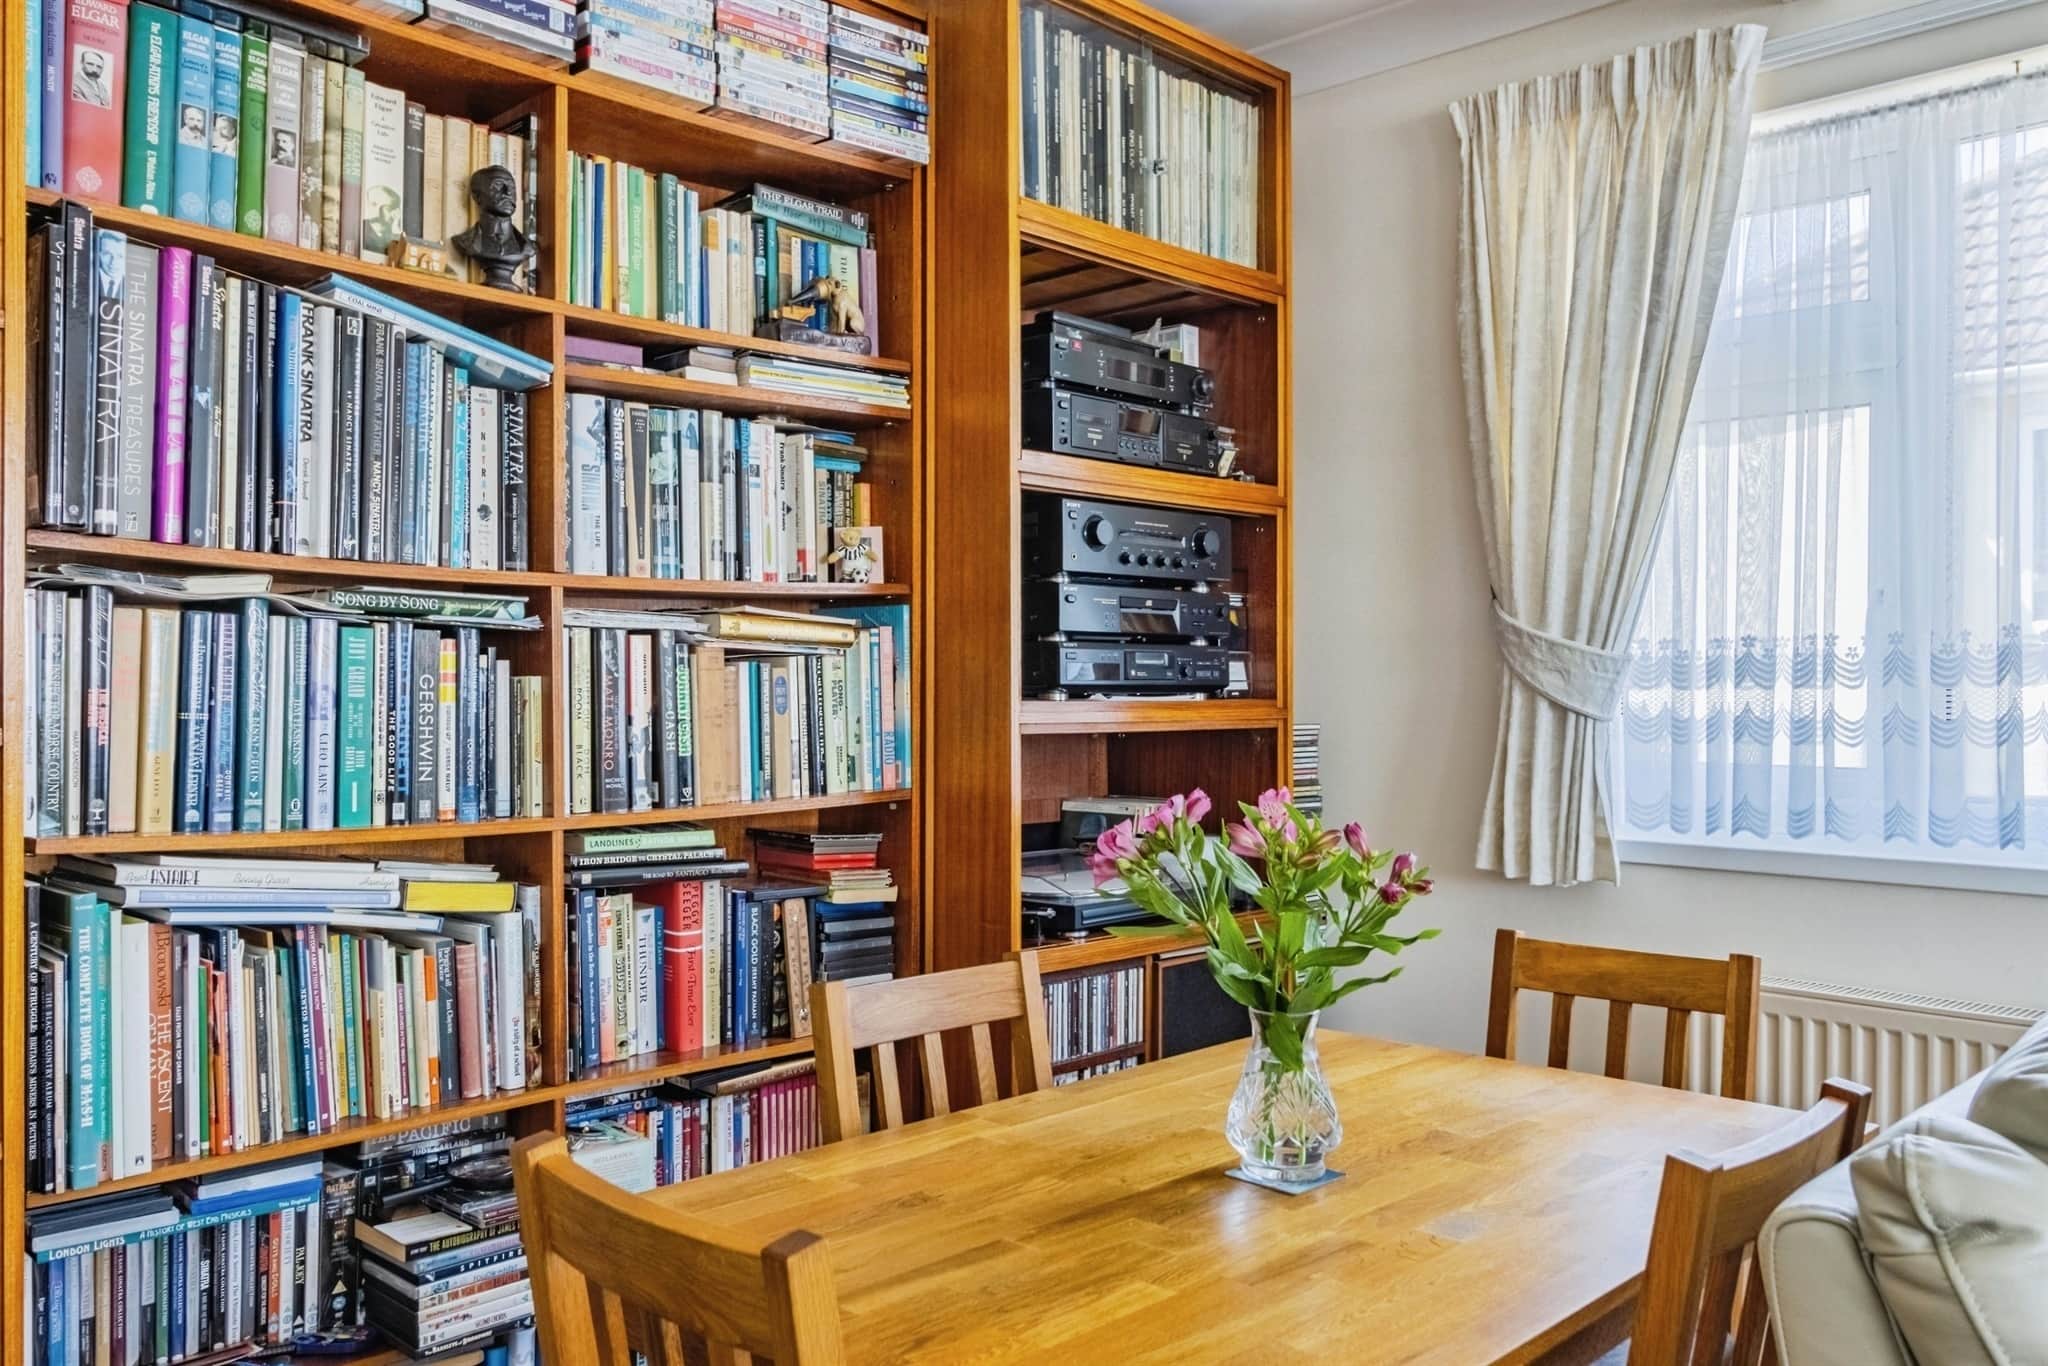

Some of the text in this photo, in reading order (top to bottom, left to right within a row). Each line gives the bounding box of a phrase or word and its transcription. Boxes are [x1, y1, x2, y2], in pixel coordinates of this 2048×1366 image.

[72, 8, 120, 29] ELGAR
[146, 96, 161, 145] FRIENDSHIP
[73, 217, 87, 250] Sinatra
[201, 265, 212, 296] Sinatra
[212, 281, 227, 331] Sinatra
[375, 322, 385, 356] FRANK
[97, 300, 123, 443] SINATRA
[124, 271, 147, 496] THE SINATRA TREASURES
[299, 304, 314, 443] FRANK SINATRA
[406, 345, 420, 426] SINATRA
[509, 404, 524, 486] SINATRA
[613, 407, 625, 461] Sinatra
[372, 460, 382, 495] NANCY
[370, 495, 381, 537] SINATRA
[334, 590, 439, 611] SONG BY SONG
[348, 666, 366, 698] GARLAND
[418, 673, 433, 782] GERSHWIN
[603, 675, 614, 770] MATT MONRO
[678, 664, 691, 757] JOHNNY CASH
[47, 723, 62, 759] MORSE
[666, 710, 675, 752] CASH
[884, 731, 895, 765] RADIO
[318, 733, 329, 794] CLEO LAINE
[387, 710, 396, 792] THE GOOD LIFE
[46, 761, 61, 812] COUNTRY
[579, 856, 603, 866] IRON
[604, 854, 637, 865] BRIDGE
[646, 851, 683, 863] CRYSTAL
[589, 838, 634, 849] LANDLINES
[150, 868, 201, 887] ASTAIRE
[674, 868, 709, 878] SANTIAGO
[30, 921, 38, 929] A
[682, 883, 691, 930] SEEGER
[691, 886, 700, 925] PEGGY
[29, 930, 39, 970] CENTURY
[309, 925, 317, 952] NEWTON
[751, 907, 759, 965] BLACK GOLD
[29, 973, 38, 983] OF
[639, 936, 648, 1003] THUNDER
[687, 950, 697, 1027] First Time Ever
[78, 926, 92, 1081] THE COMPLETE BOOK OF
[155, 930, 172, 1113] J.Bronowski THE ASCENT
[300, 987, 310, 1049] NEWTON ABBOT
[45, 992, 54, 1109] THE BLACK COUNTRY ALBUM
[28, 1076, 38, 1106] MINERS
[28, 1109, 37, 1119] IN
[396, 1119, 471, 1144] PACIFIC
[27, 1122, 37, 1161] PICTURES
[48, 1236, 125, 1260] LONDON LIGHTS
[429, 1240, 441, 1252] THE
[441, 1231, 488, 1249] AUTOBIOGRAPHY
[496, 1223, 516, 1236] JAMES
[200, 1259, 210, 1290] SINATRA
[294, 1246, 305, 1285] PAL JOEY
[460, 1247, 522, 1272] SPITFIRE
